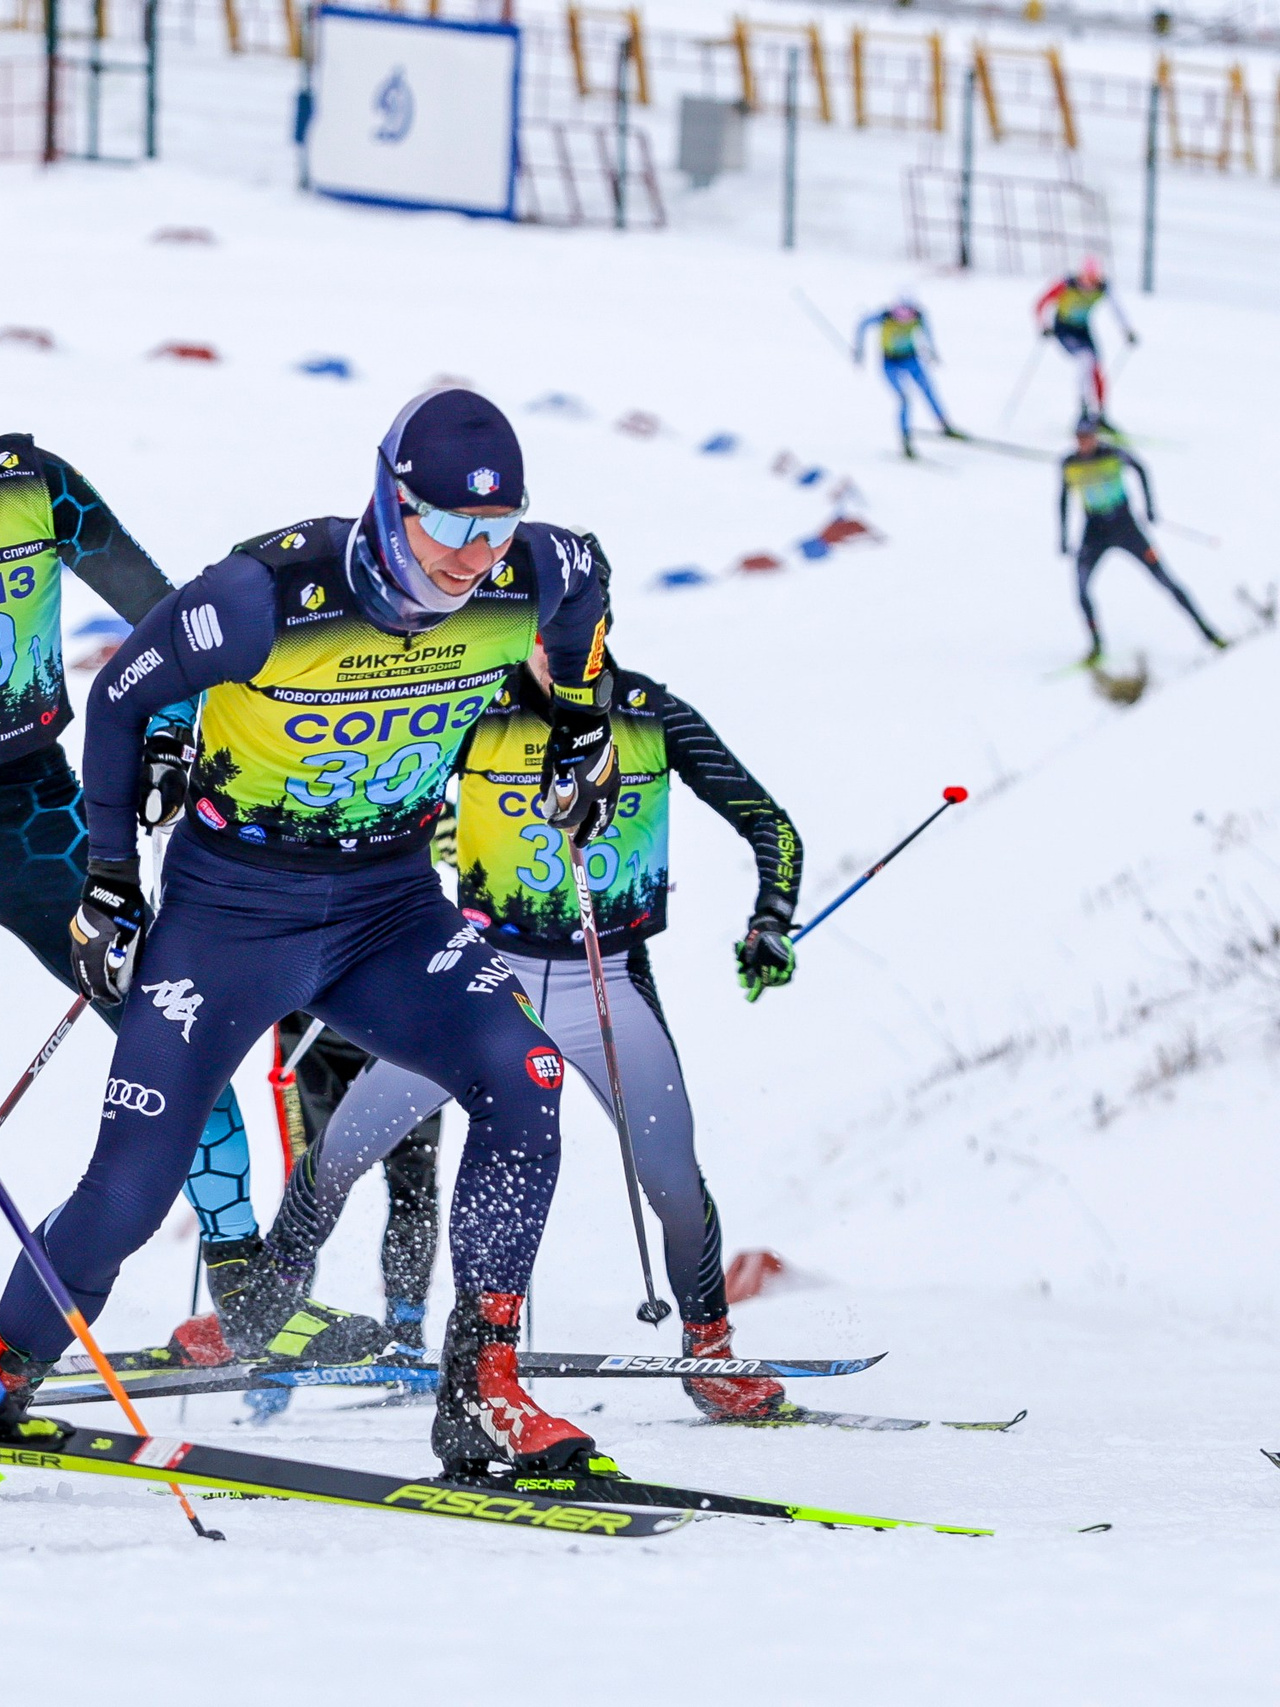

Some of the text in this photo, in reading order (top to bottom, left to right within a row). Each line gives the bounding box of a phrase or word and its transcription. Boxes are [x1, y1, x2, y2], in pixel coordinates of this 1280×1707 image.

[2, 541, 43, 561] СПРИНТ
[338, 644, 467, 669] ВИКТОРИЯ
[390, 666, 412, 677] мы
[413, 660, 460, 673] строим
[274, 669, 505, 704] НОВОГОДНИЙ КОМАНДНЫЙ СПРИНТ
[285, 741, 441, 808] 30
[516, 823, 621, 893] 36
[532, 1055, 560, 1069] RTL
[538, 1069, 561, 1079] 102.5
[514, 1478, 575, 1491] FISCHER
[383, 1483, 632, 1536] FISCHER
